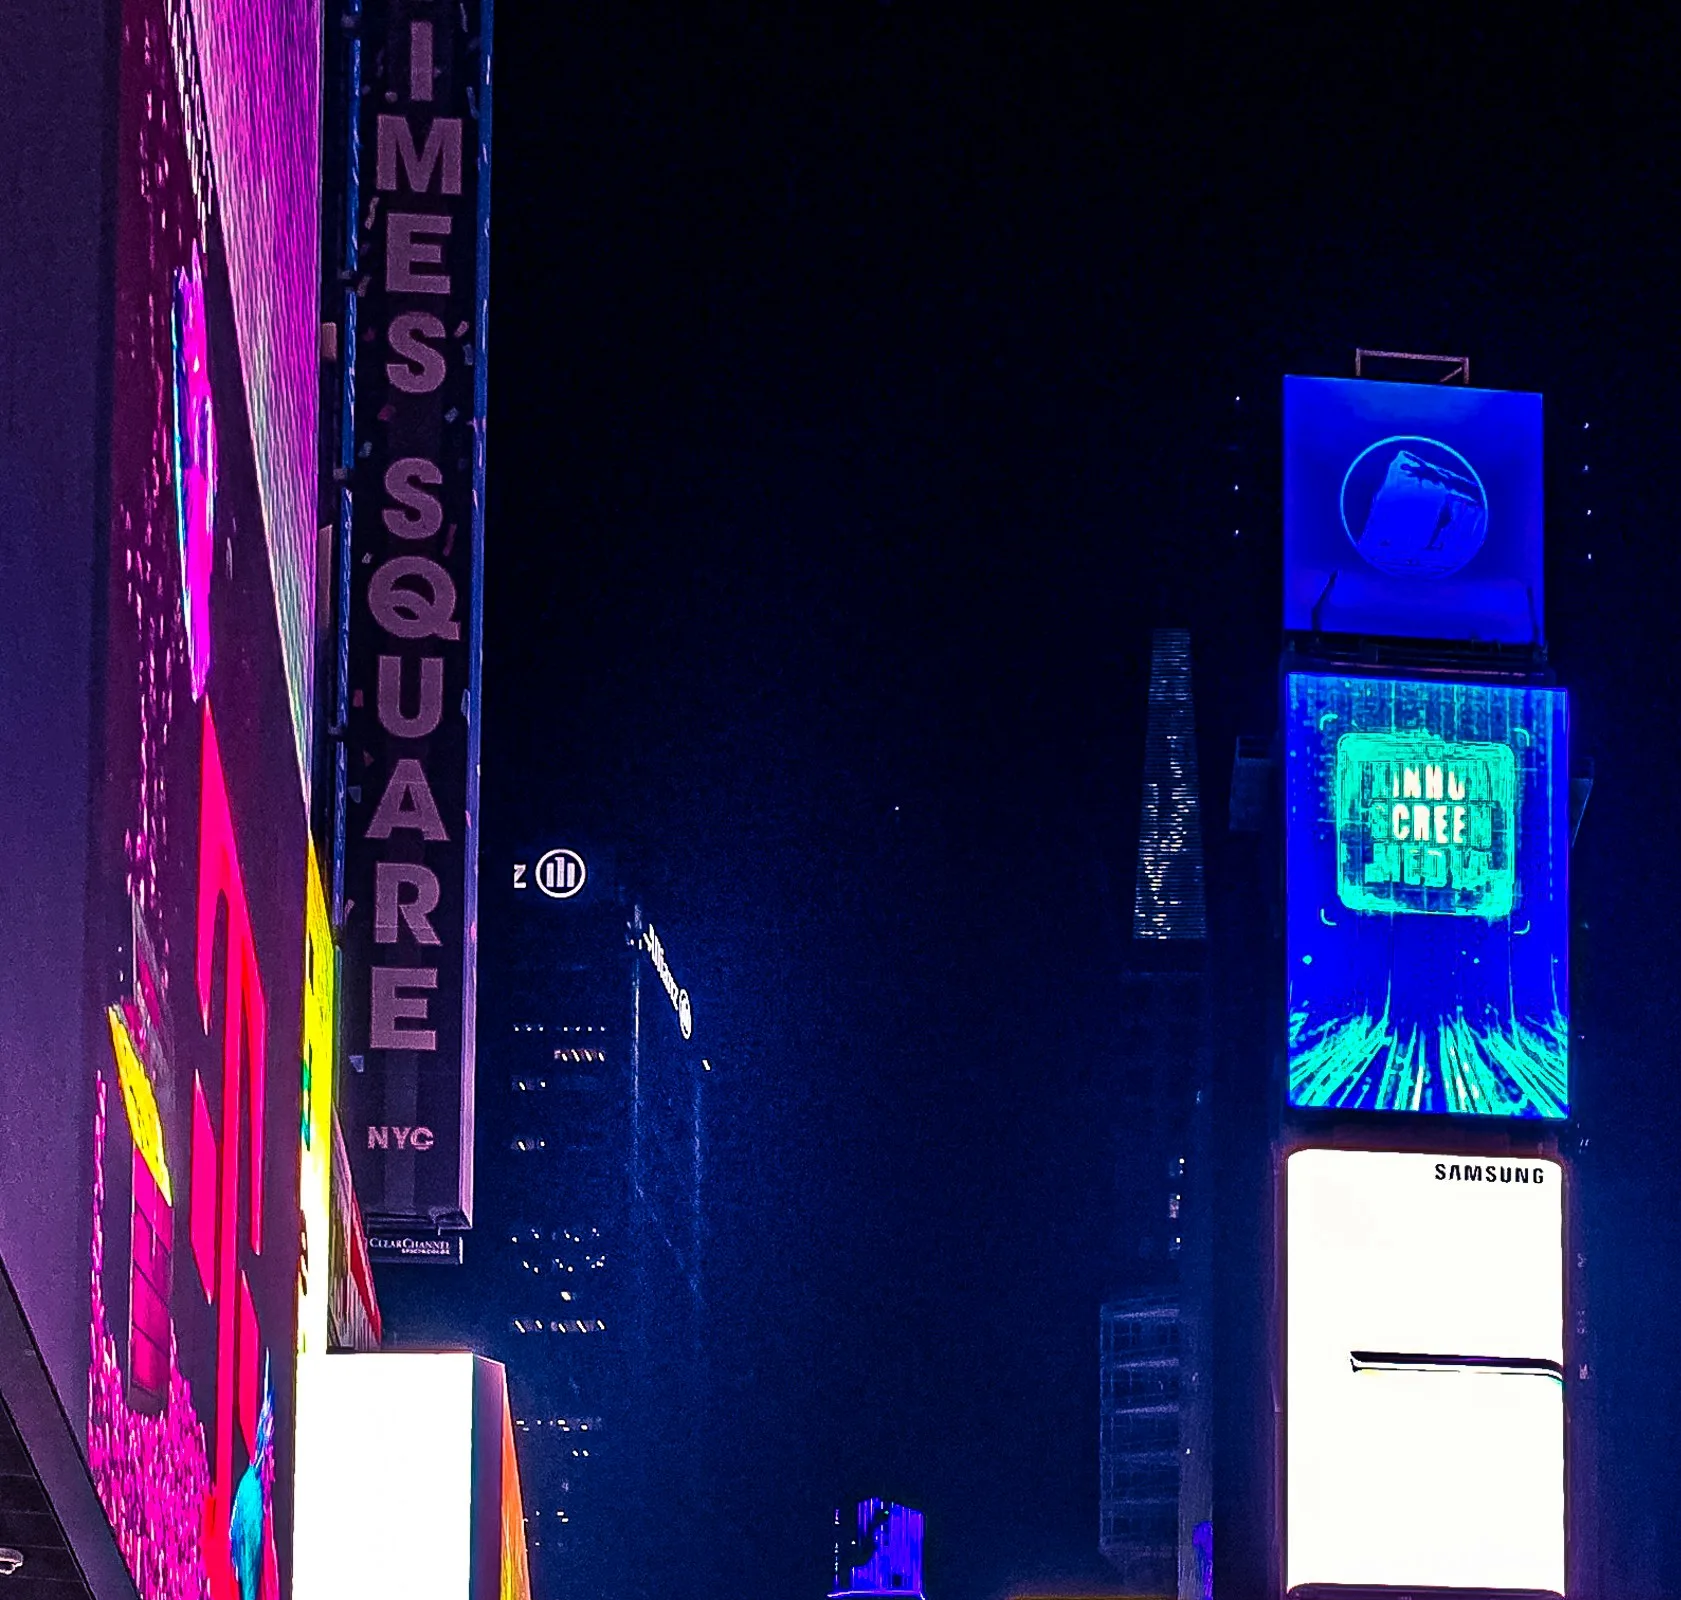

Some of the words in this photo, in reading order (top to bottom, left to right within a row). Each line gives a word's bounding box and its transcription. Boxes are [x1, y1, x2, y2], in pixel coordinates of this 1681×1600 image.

[364, 457, 461, 1051] SQUARE
[367, 1126, 434, 1150] NYC
[1433, 1163, 1546, 1185] SAMSUNG
